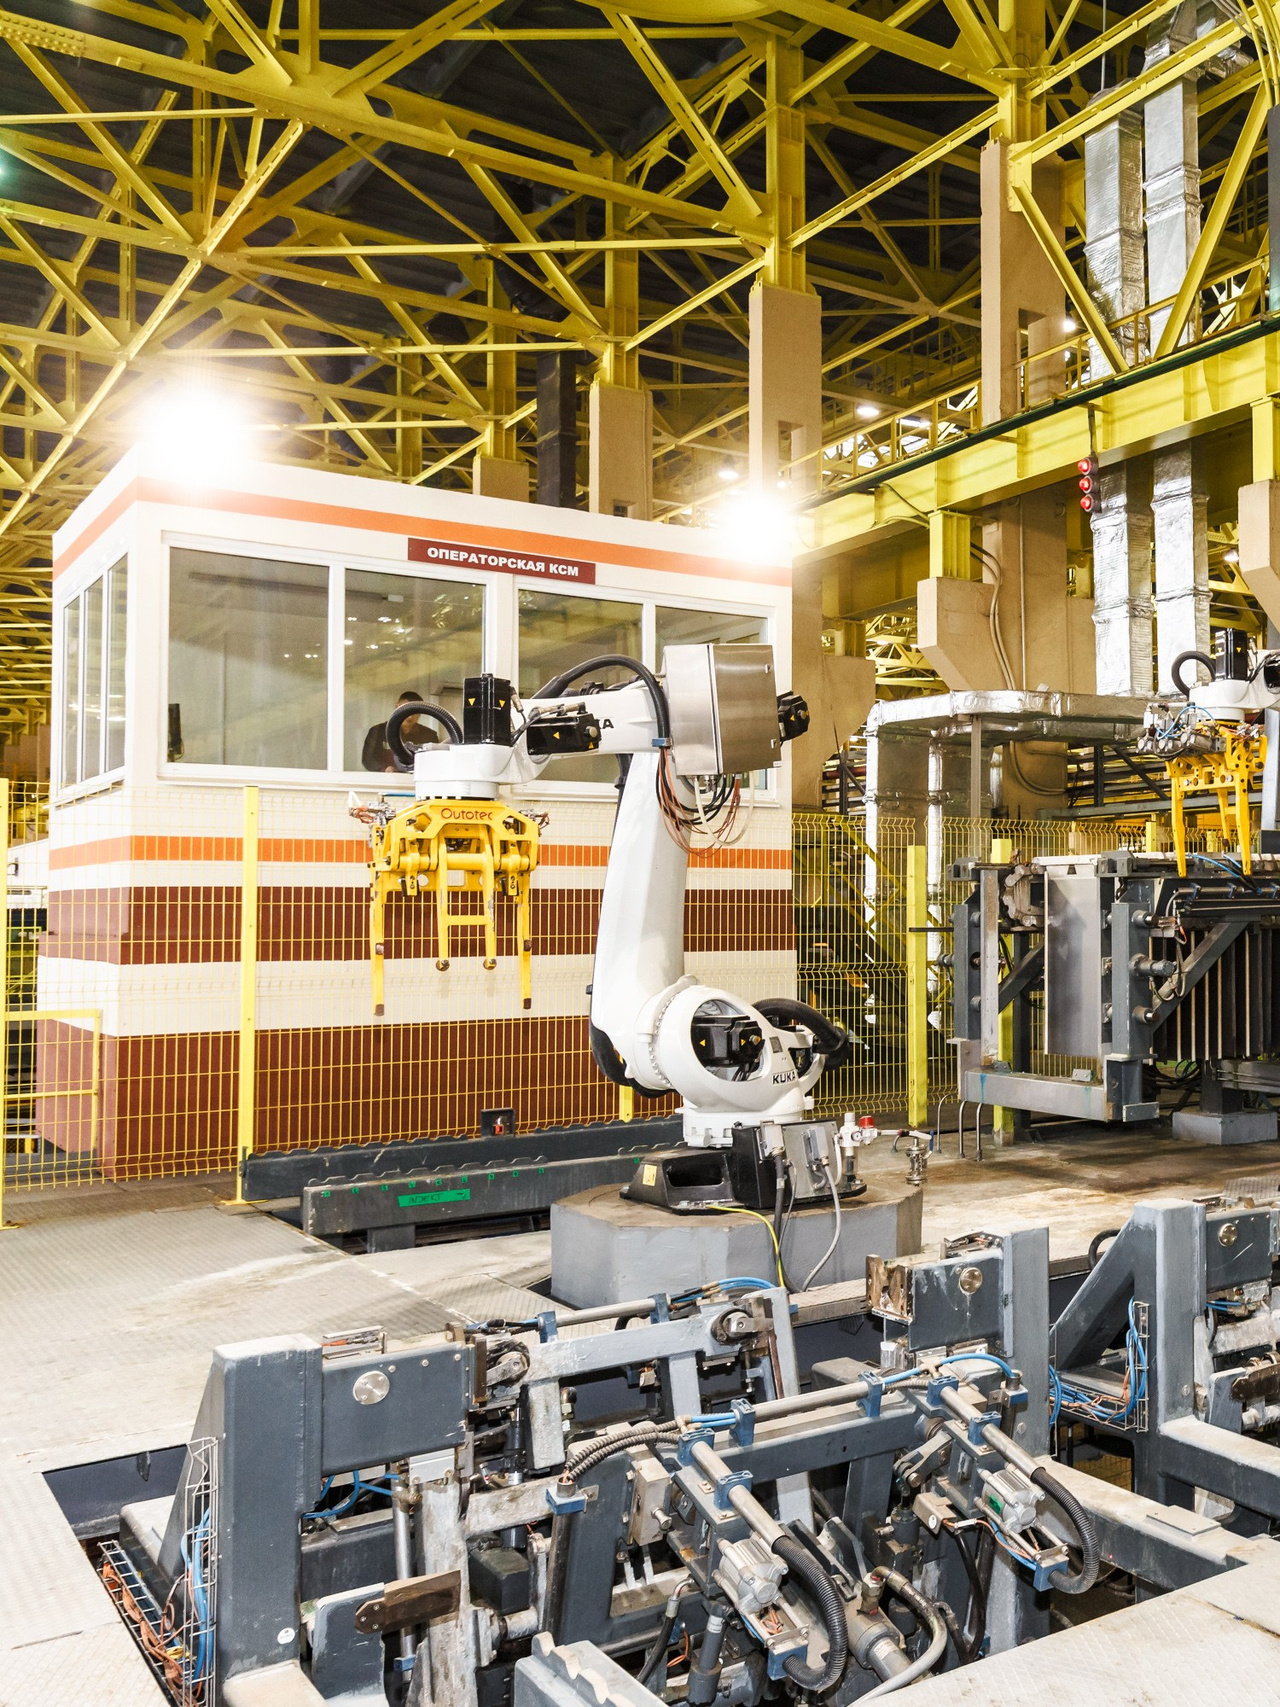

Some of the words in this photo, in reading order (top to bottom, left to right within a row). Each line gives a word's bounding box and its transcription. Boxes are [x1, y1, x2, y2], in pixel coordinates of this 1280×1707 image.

[427, 547, 545, 572] ОПЕРАТОРСКАЯ
[549, 563, 579, 577] КСМ
[441, 807, 493, 821] Outotec
[772, 1071, 796, 1085] KUKA
